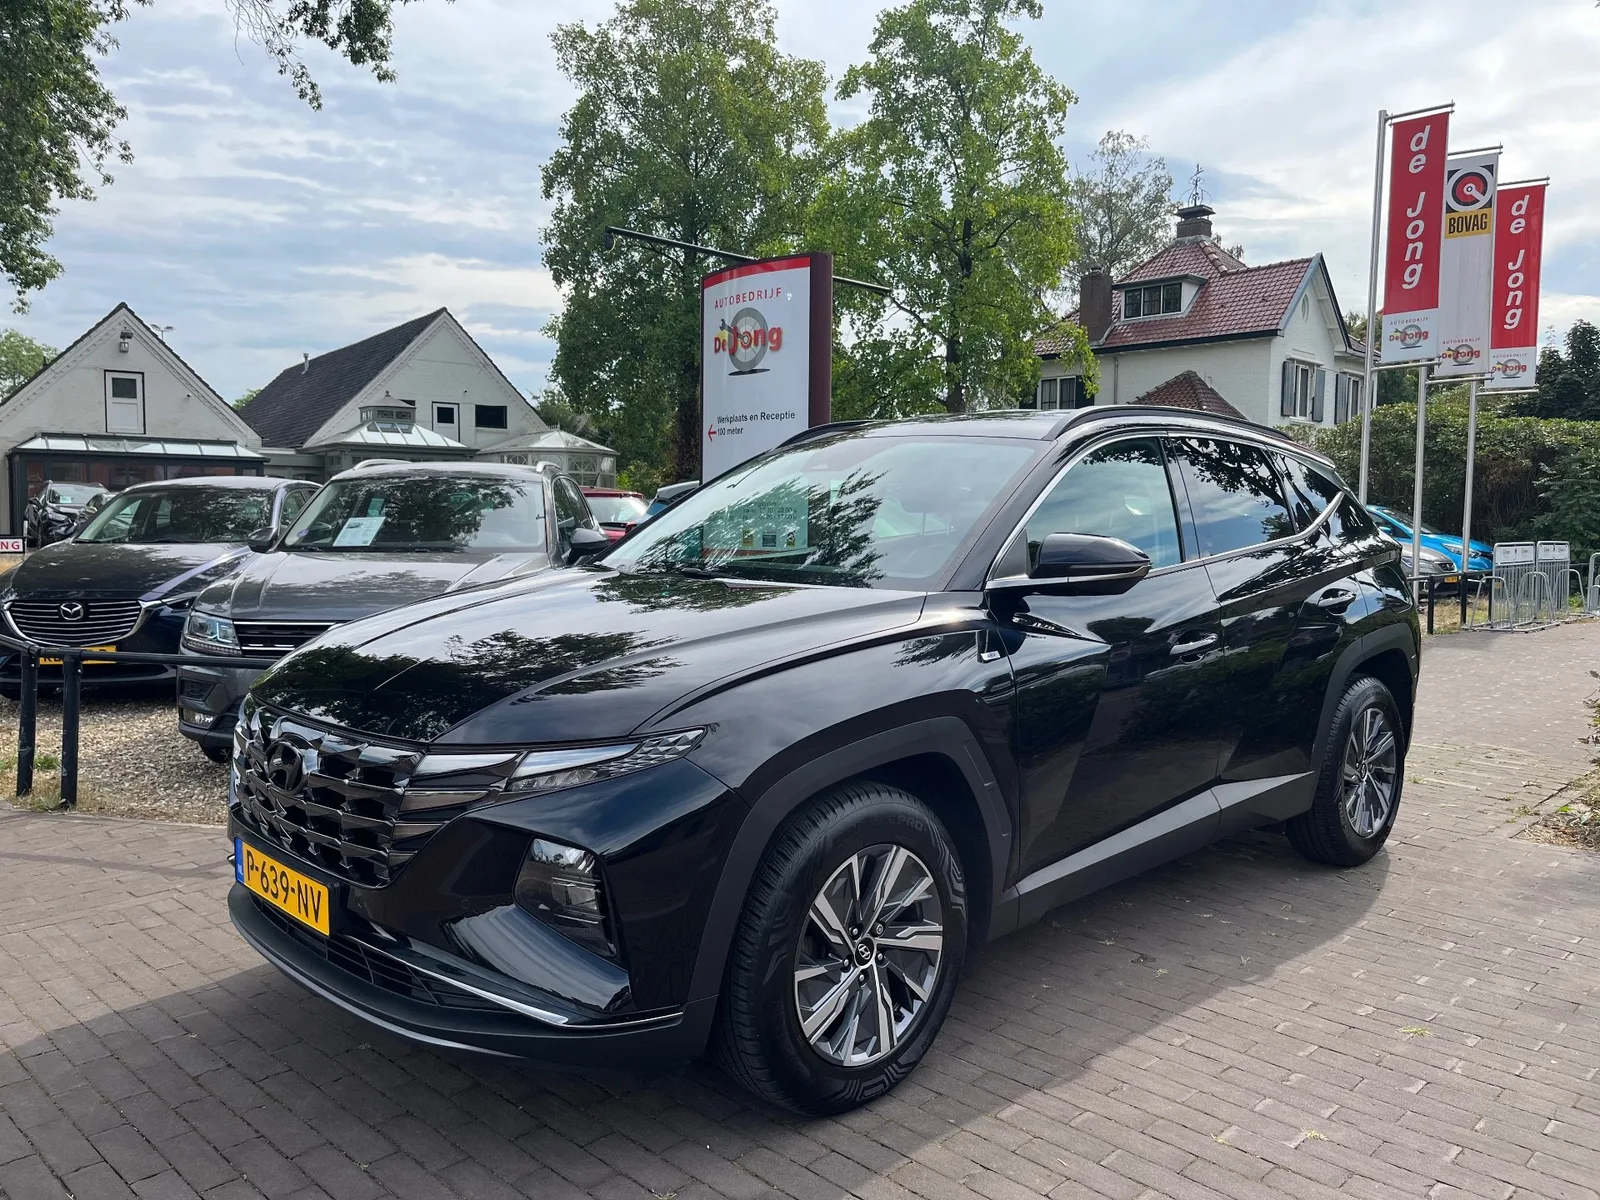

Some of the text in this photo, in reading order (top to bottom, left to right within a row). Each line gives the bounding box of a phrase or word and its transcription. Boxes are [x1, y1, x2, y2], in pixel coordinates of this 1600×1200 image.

[1402, 125, 1431, 290] de Jong
[1448, 212, 1488, 235] BOVAG
[1504, 195, 1529, 330] de Jong
[714, 287, 782, 310] AUTOBEDRIJF
[717, 410, 796, 425] Werkplaats en Receptie
[726, 427, 744, 435] meter
[246, 849, 322, 924] P-639-NV
